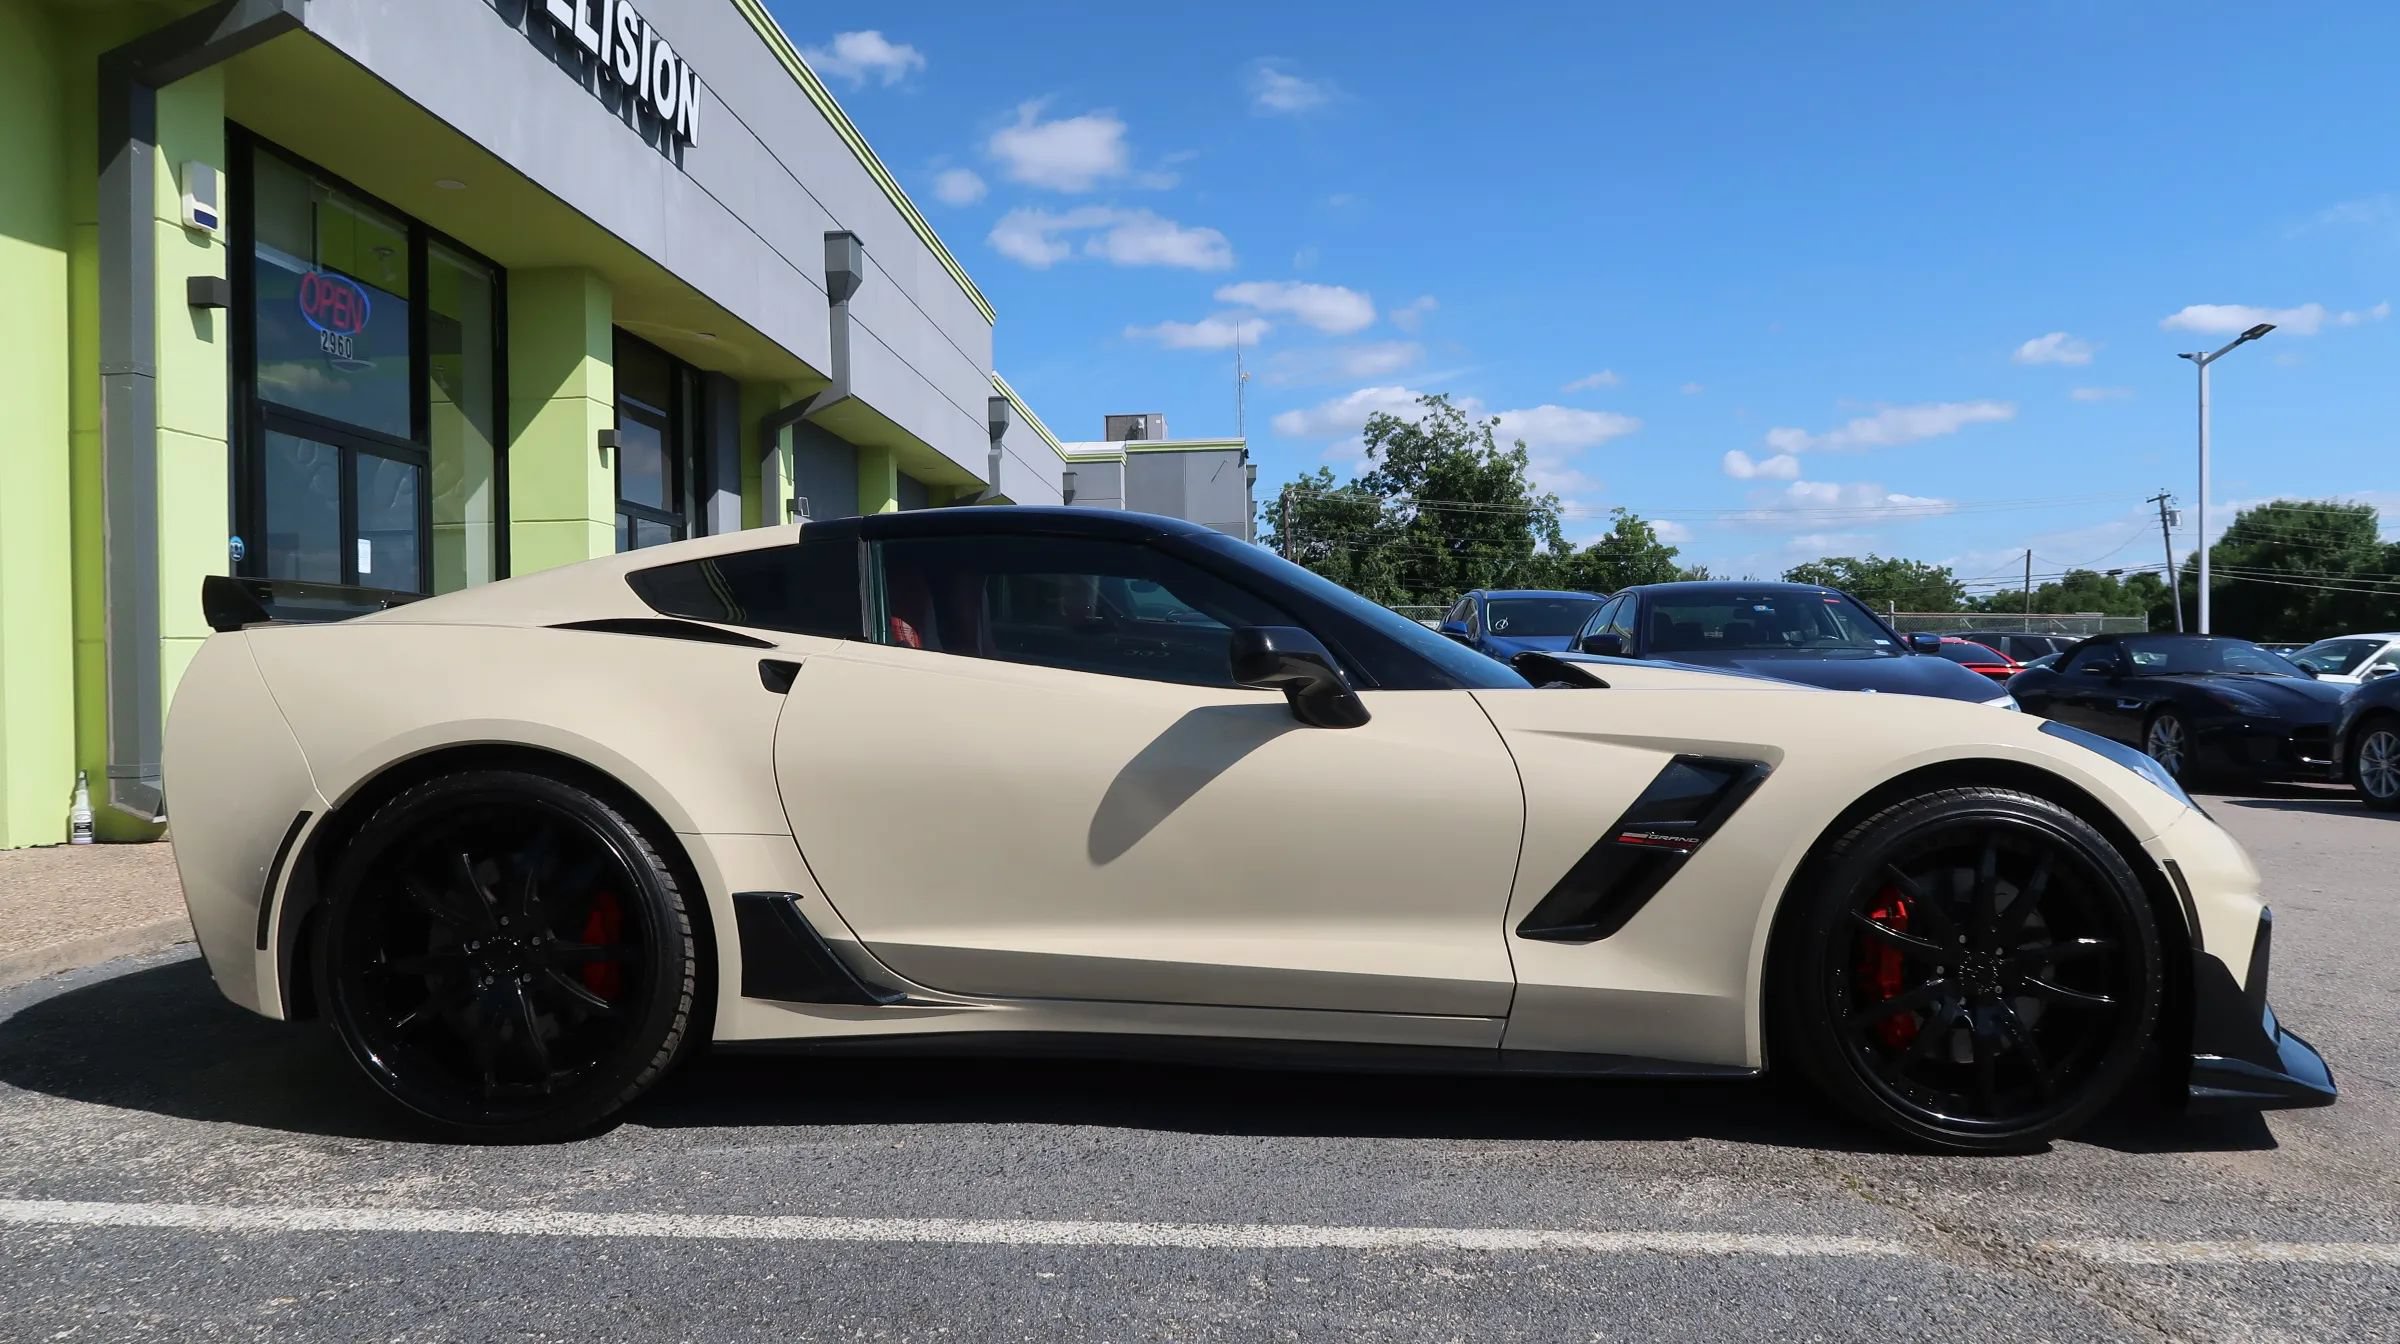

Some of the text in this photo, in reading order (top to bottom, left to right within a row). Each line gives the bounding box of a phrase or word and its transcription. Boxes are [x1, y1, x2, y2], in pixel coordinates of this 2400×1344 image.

[546, 0, 701, 148] LISION
[301, 272, 364, 335] OPEN
[321, 330, 352, 359] 2960
[1648, 833, 1700, 843] GRAND
